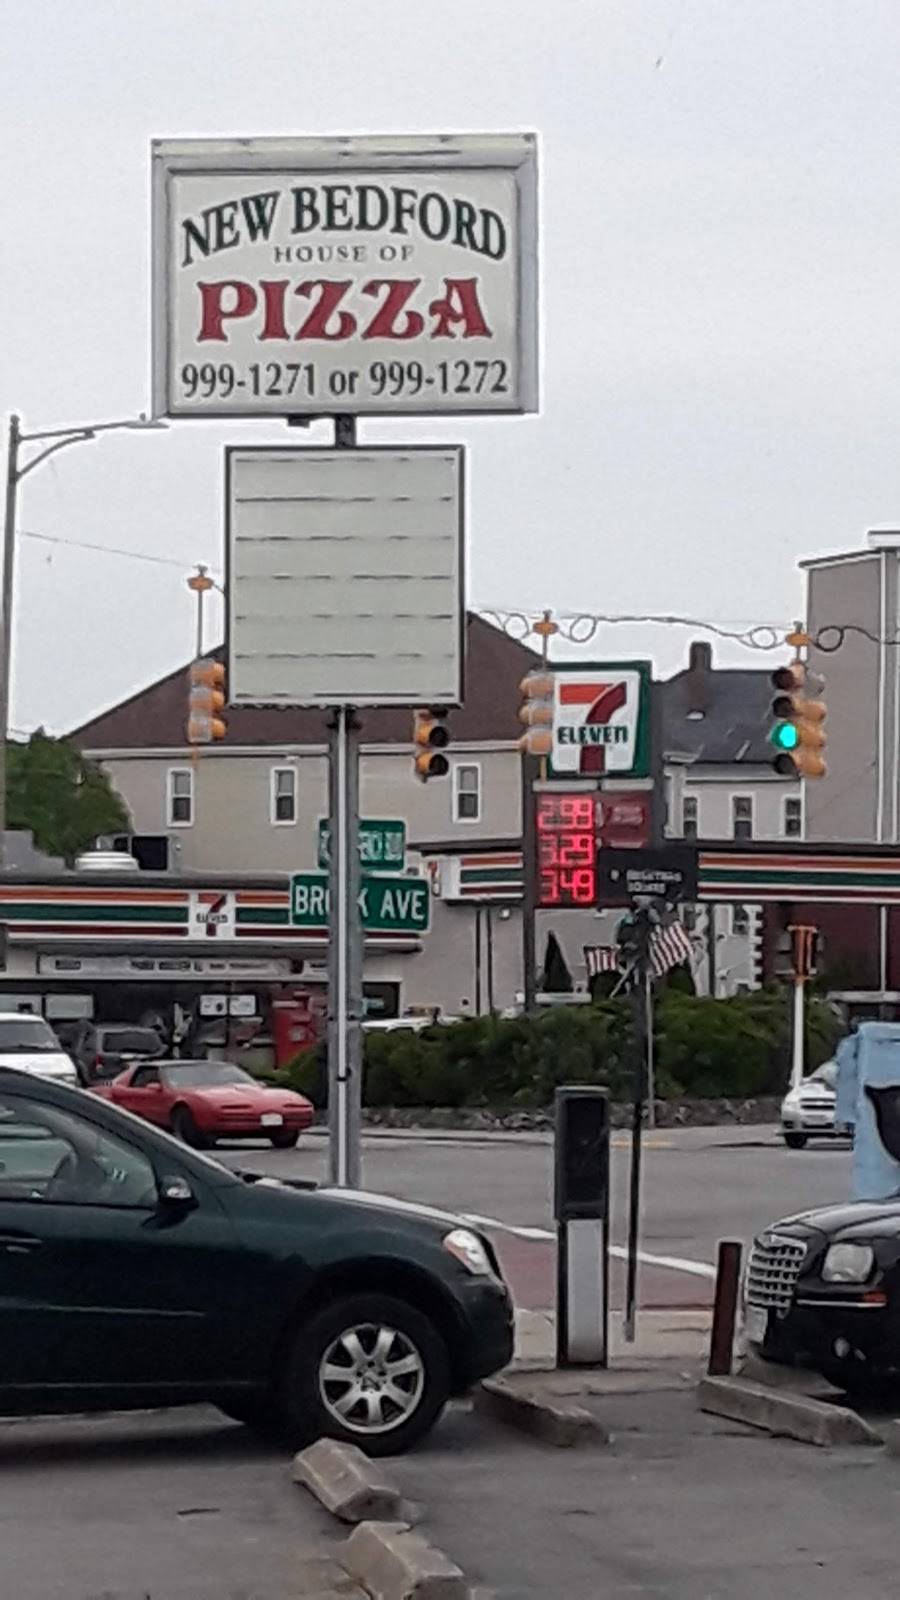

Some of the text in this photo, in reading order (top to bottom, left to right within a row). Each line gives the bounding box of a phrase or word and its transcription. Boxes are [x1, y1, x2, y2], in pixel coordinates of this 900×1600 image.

[181, 185, 506, 268] NEW BEDFORD
[274, 246, 413, 262] HOUSE OF
[197, 278, 493, 342] PIZZA
[182, 361, 507, 397] 999-1271 or 999-1272
[560, 681, 627, 774] 7
[198, 893, 227, 937] 7
[295, 885, 425, 920] BRK AVE
